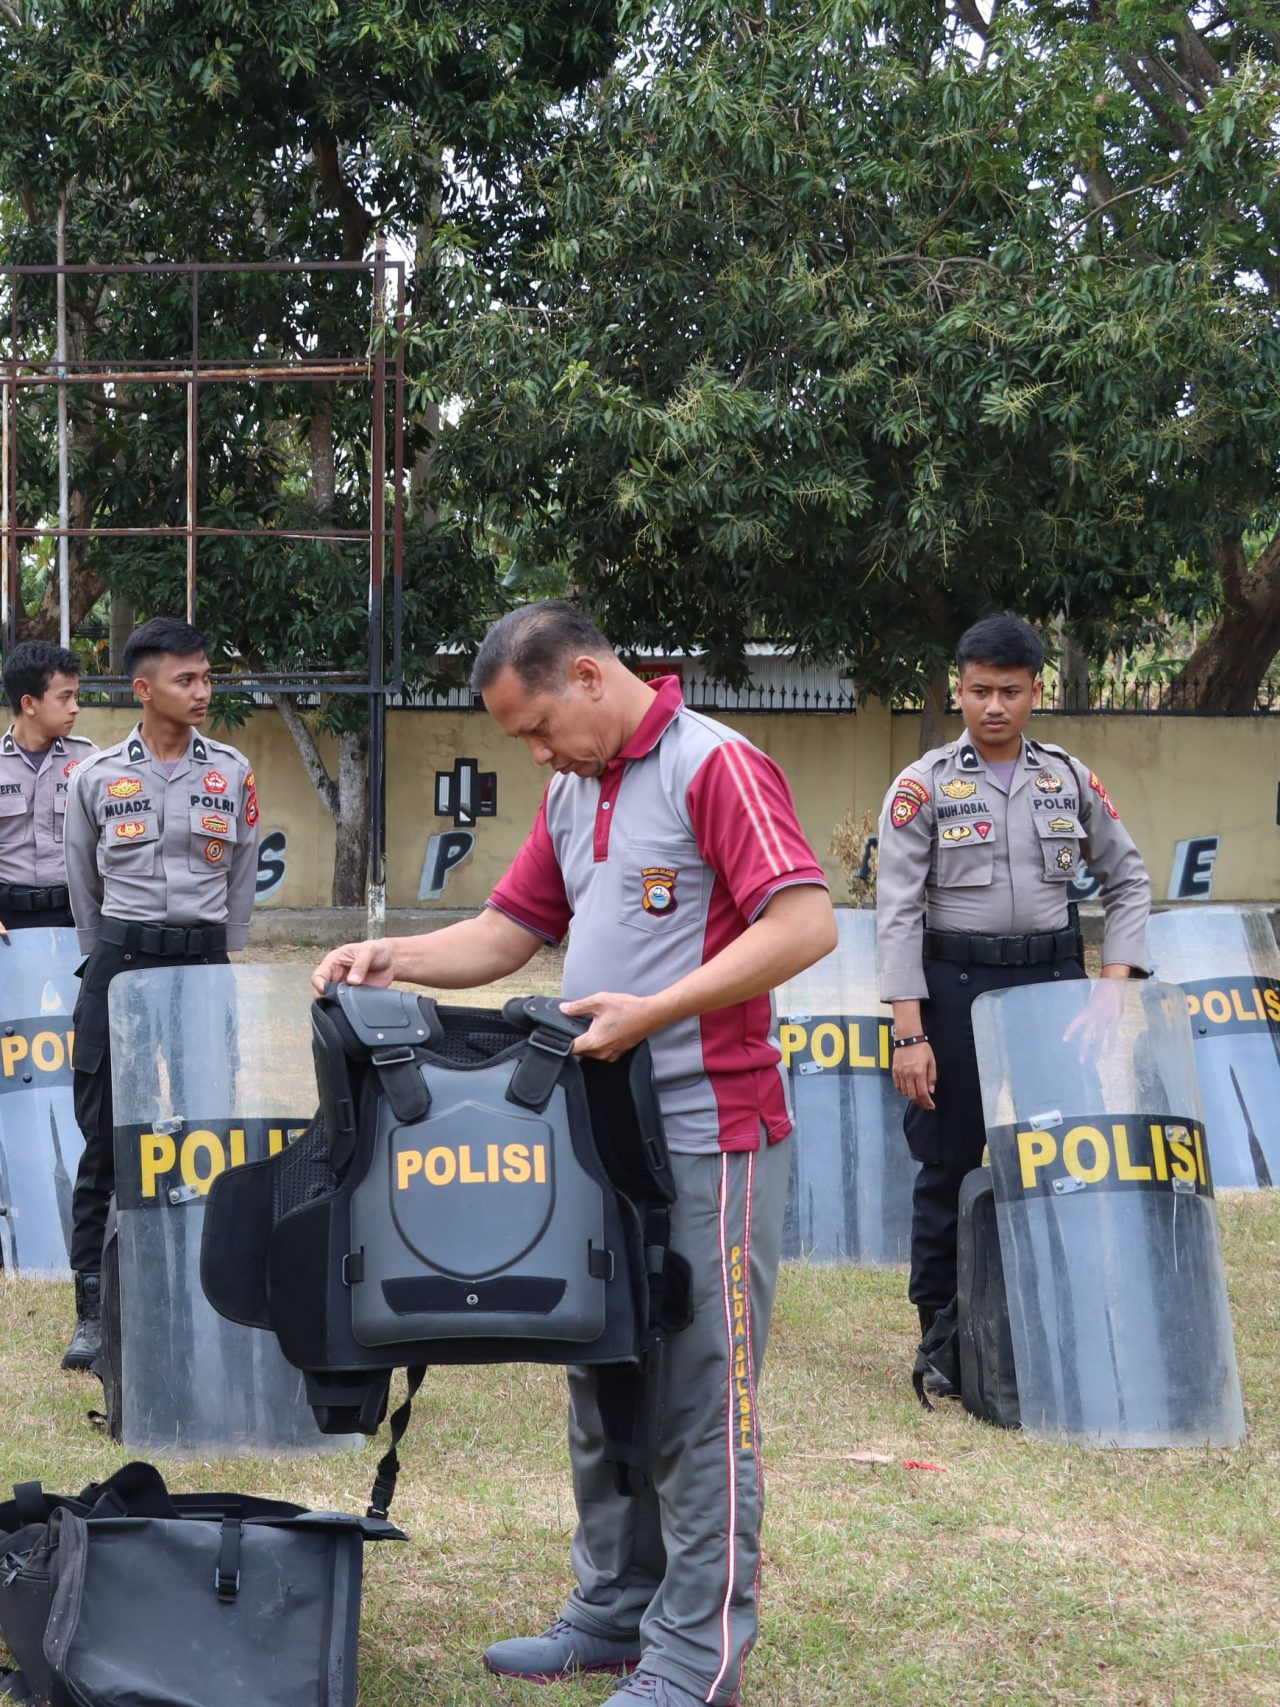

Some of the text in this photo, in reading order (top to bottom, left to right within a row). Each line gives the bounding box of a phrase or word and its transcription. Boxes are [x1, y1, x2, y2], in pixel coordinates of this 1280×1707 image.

[104, 798, 153, 819] MUADZ
[190, 794, 235, 813] POLRI
[936, 802, 990, 819] MUH.IQBAL
[1033, 797, 1077, 811] POLRI
[397, 1143, 546, 1190] POLISI
[1017, 1124, 1206, 1189] POLISI
[731, 1245, 752, 1450] POLDA SULSEL
